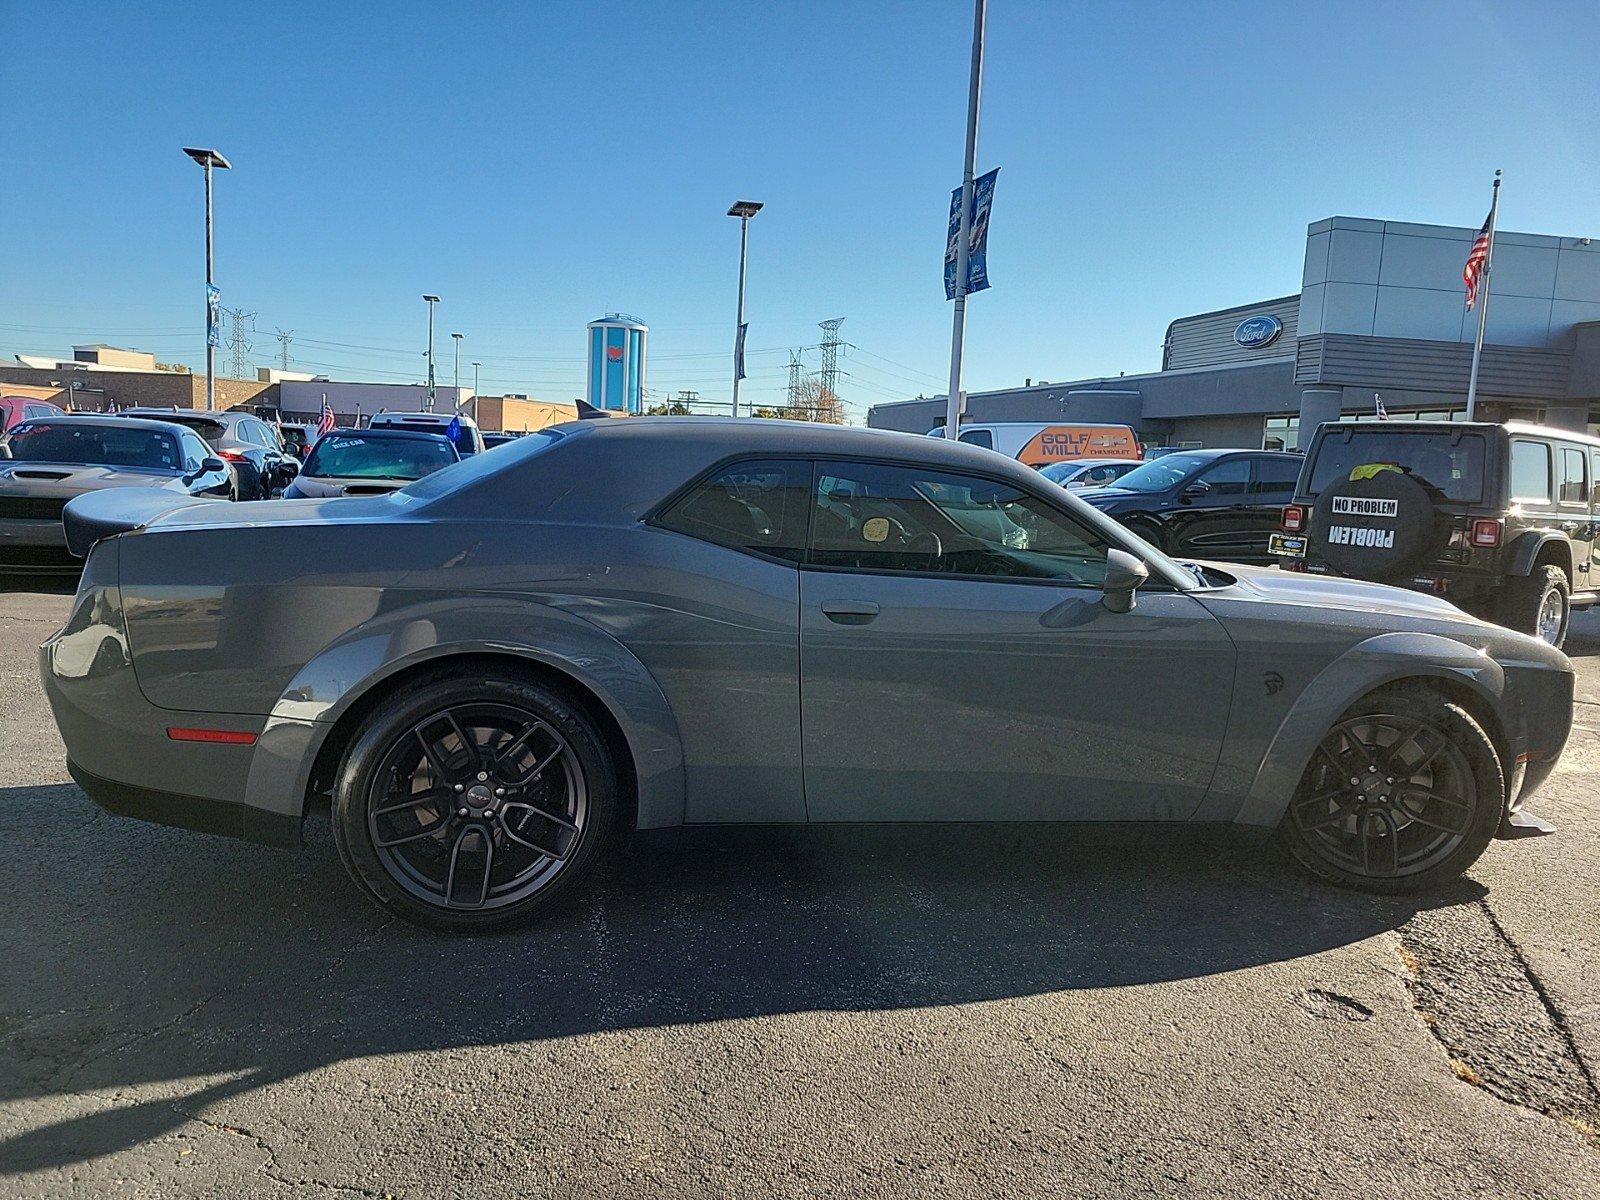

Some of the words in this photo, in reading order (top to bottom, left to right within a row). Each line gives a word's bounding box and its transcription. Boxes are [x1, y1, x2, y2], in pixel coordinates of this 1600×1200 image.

[1240, 321, 1268, 342] Ford
[1041, 433, 1088, 445] GOLF
[1042, 444, 1082, 456] MILL
[1334, 499, 1348, 512] NO
[1350, 500, 1396, 514] PROBLEM
[1328, 525, 1395, 548] PROBLEM
